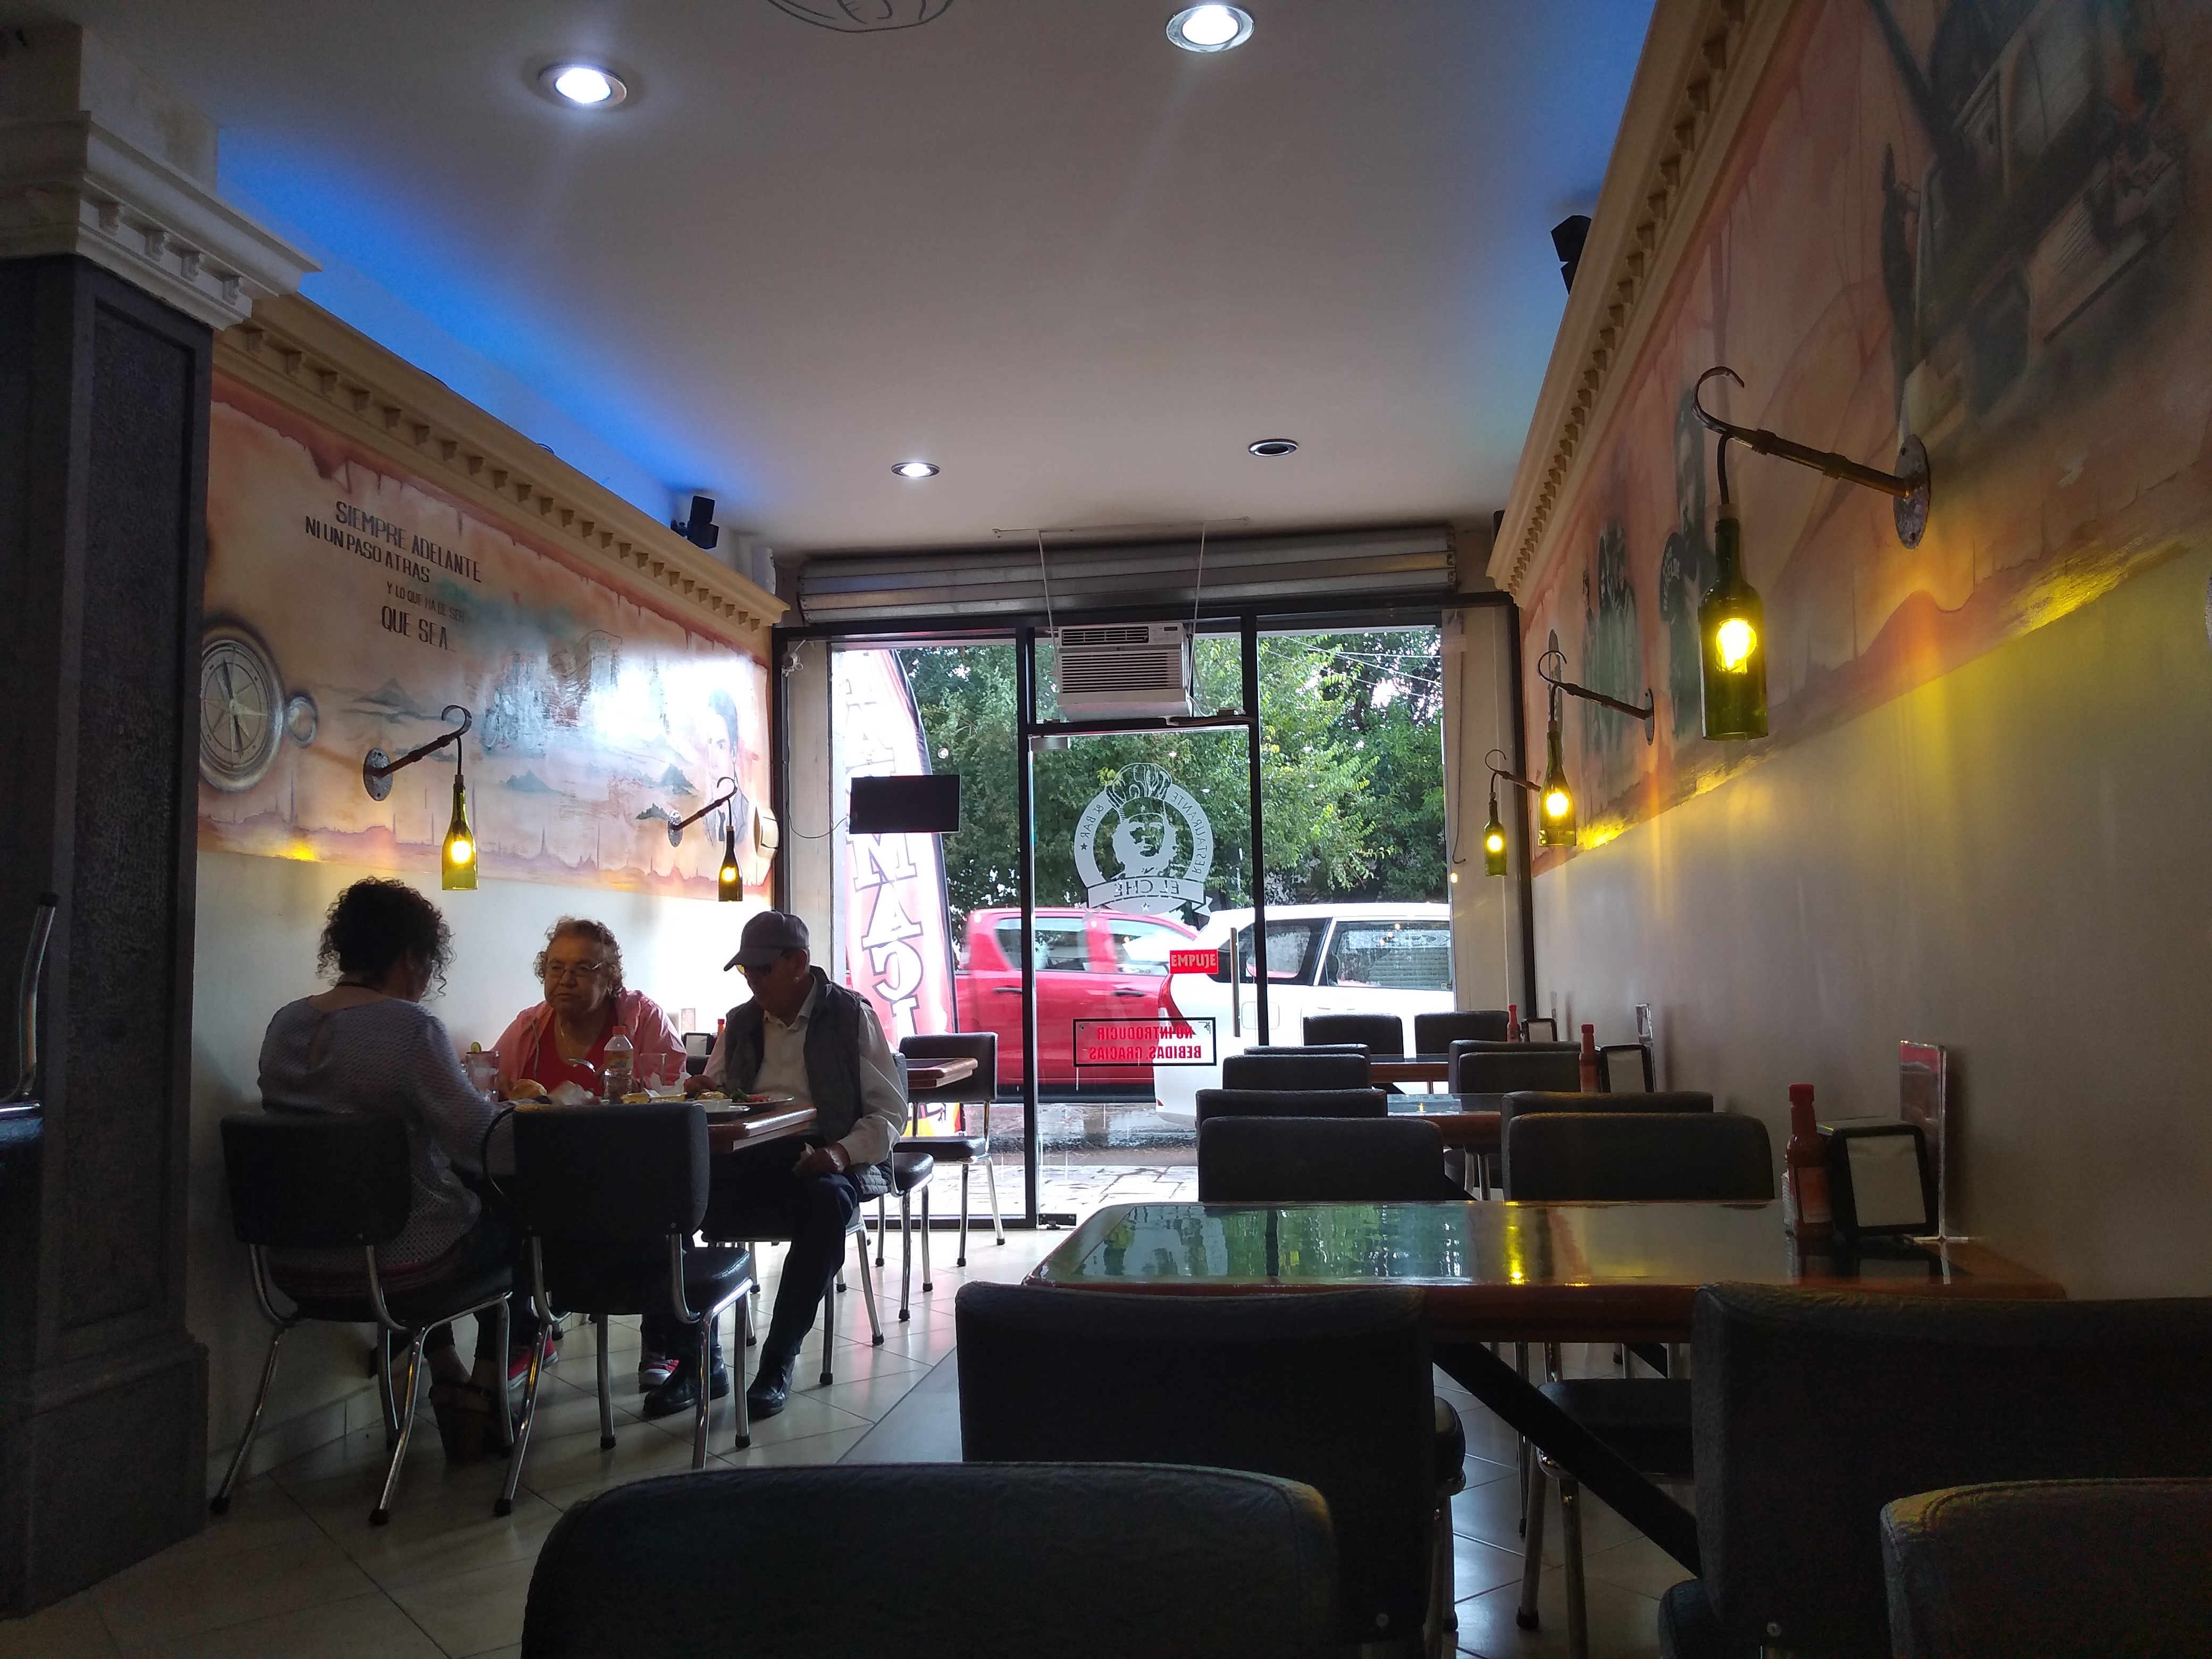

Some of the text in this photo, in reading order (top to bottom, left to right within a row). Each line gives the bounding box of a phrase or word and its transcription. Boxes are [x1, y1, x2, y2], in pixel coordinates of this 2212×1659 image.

[306, 516, 430, 583] NI UN PASO ATRAS
[336, 501, 481, 583] SIEMPRE ADELANTE
[381, 606, 411, 637] QUE
[387, 581, 393, 594] Y
[396, 585, 405, 599] LO
[407, 590, 422, 606] QUE
[449, 607, 465, 623] SER
[1171, 954, 1217, 968] EMPUJE
